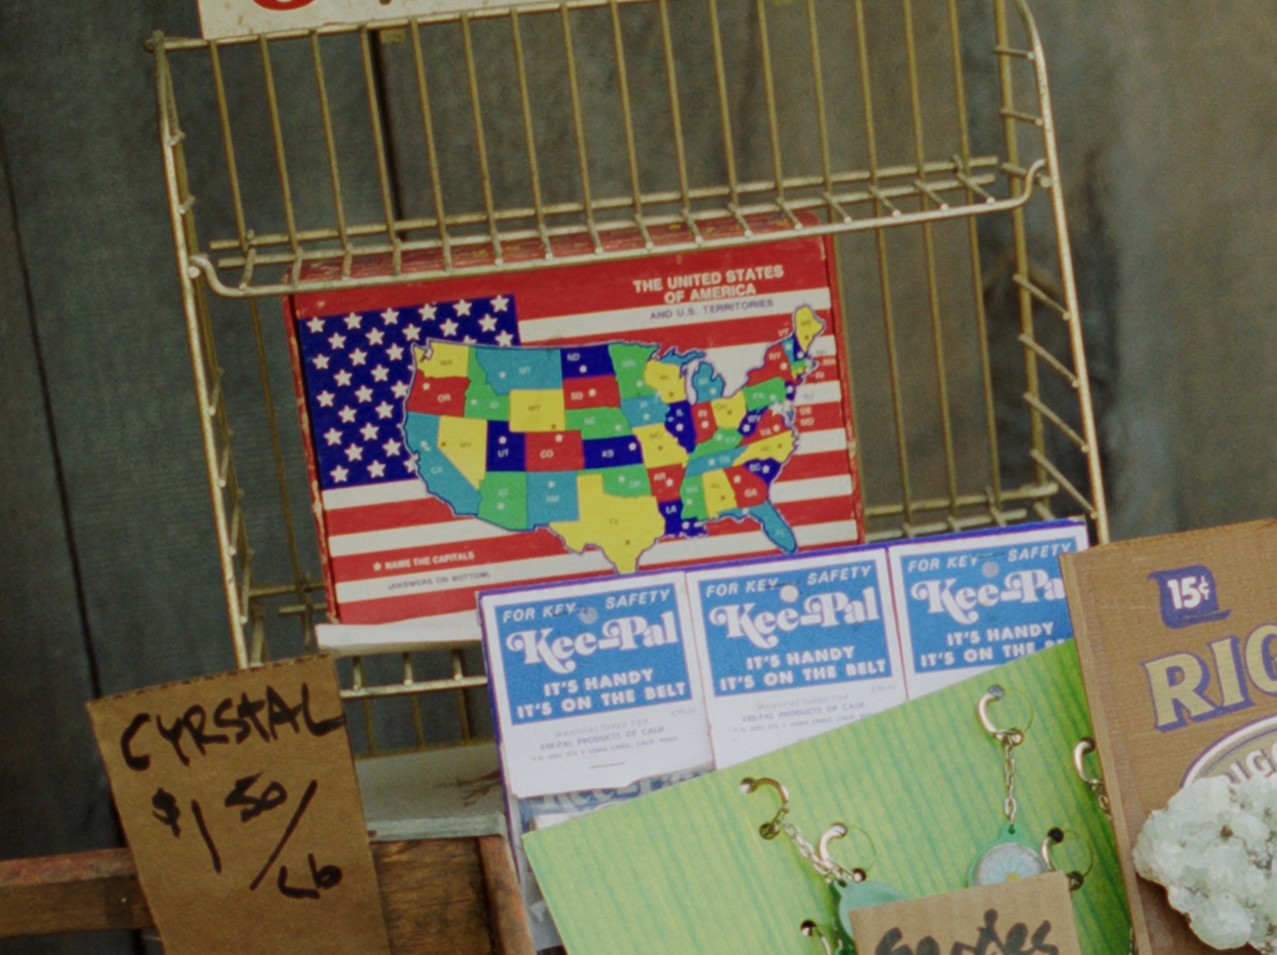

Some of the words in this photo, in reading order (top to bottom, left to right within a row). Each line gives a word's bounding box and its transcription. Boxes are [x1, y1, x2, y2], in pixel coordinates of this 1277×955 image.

[633, 278, 663, 293] THE
[667, 271, 722, 290] UNITED
[725, 265, 784, 282] STATES
[664, 291, 685, 304] OF
[690, 283, 756, 302] AMERICA
[650, 309, 672, 320] AND
[703, 299, 775, 315] TERRITORIES
[385, 559, 411, 570] NAME
[413, 556, 431, 567] THE
[432, 551, 475, 566] CAPITALS
[907, 559, 940, 574] FOR
[946, 553, 979, 570] KEY
[1007, 542, 1073, 563] SAFETY
[705, 582, 739, 598] FOR
[745, 578, 780, 593] KEY
[807, 565, 871, 586] SAFETY
[910, 568, 1067, 626] Kee-Pa
[1167, 574, 1211, 611] 15¢
[502, 607, 535, 623] FOR
[542, 602, 577, 618] KEY
[605, 588, 671, 610] SAFETY
[708, 587, 880, 650] Kee-Pal
[505, 611, 679, 675] Kee-Pal
[946, 630, 980, 647] IT'S
[987, 622, 1054, 643] HANDY
[745, 653, 780, 671] IT'S
[787, 645, 856, 666] HANDY
[920, 650, 956, 668] IT'S
[964, 644, 995, 663] ON
[1002, 640, 1036, 658] THE
[543, 680, 578, 697] IT'S
[584, 668, 654, 692] HANDY
[719, 675, 755, 692] IT'S
[763, 669, 794, 686] ON
[803, 663, 838, 681] THE
[845, 658, 886, 677] BELT
[516, 702, 552, 719] IT'S
[561, 694, 592, 713] ON
[600, 689, 637, 707] THE
[645, 682, 687, 700] BELT
